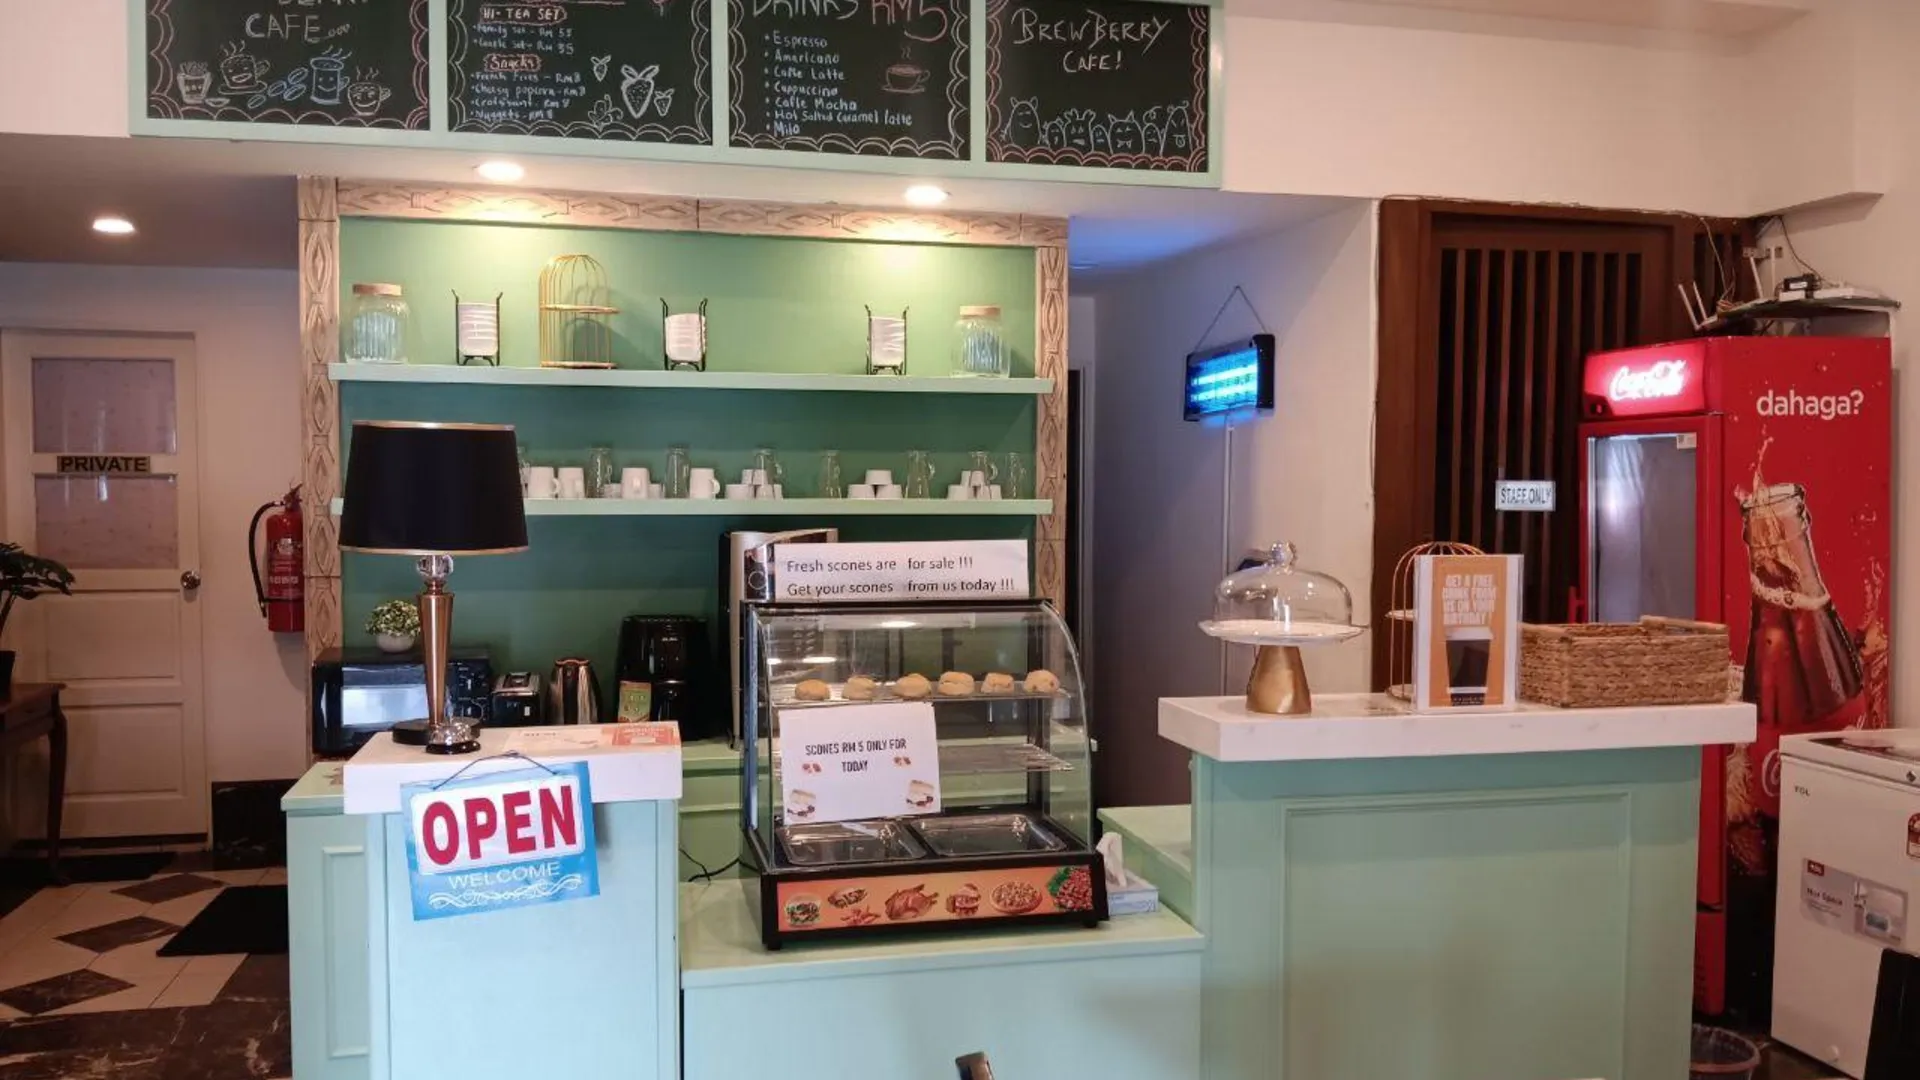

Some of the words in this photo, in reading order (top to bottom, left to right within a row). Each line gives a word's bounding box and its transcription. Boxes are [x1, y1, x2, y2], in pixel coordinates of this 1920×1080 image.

[538, 8, 560, 20] SET
[245, 13, 320, 43] CAFE
[773, 30, 828, 48] Espresso
[774, 50, 840, 64] Americano
[811, 67, 845, 81] Latte
[774, 80, 839, 98] Cappuccino
[815, 98, 858, 111] Mocha
[774, 110, 798, 121] Hot
[837, 109, 879, 124] Caramel
[774, 121, 800, 137] Milo
[1755, 389, 1865, 421] dahaga?
[60, 456, 148, 473] PRIVATE
[1501, 487, 1527, 504] STAFF
[1529, 487, 1552, 504] ONLY
[786, 560, 823, 573] Fresh
[827, 561, 872, 572] scones
[875, 560, 897, 571] are
[907, 559, 926, 570] for
[929, 557, 955, 570] sale
[959, 556, 974, 568] !!!
[786, 582, 813, 596] Get
[815, 584, 845, 598] your
[849, 582, 894, 594] scones
[907, 580, 939, 593] from
[942, 581, 957, 592] us
[960, 578, 997, 594] today
[1000, 577, 1014, 590] !!!
[805, 743, 839, 756] SCONES
[842, 741, 856, 754] RM
[858, 741, 864, 752] 5
[866, 739, 887, 751] ONLY
[889, 738, 906, 750] FOR
[841, 760, 868, 773] TODAY
[422, 785, 577, 865] OPEN
[448, 860, 560, 889] WELCOME
